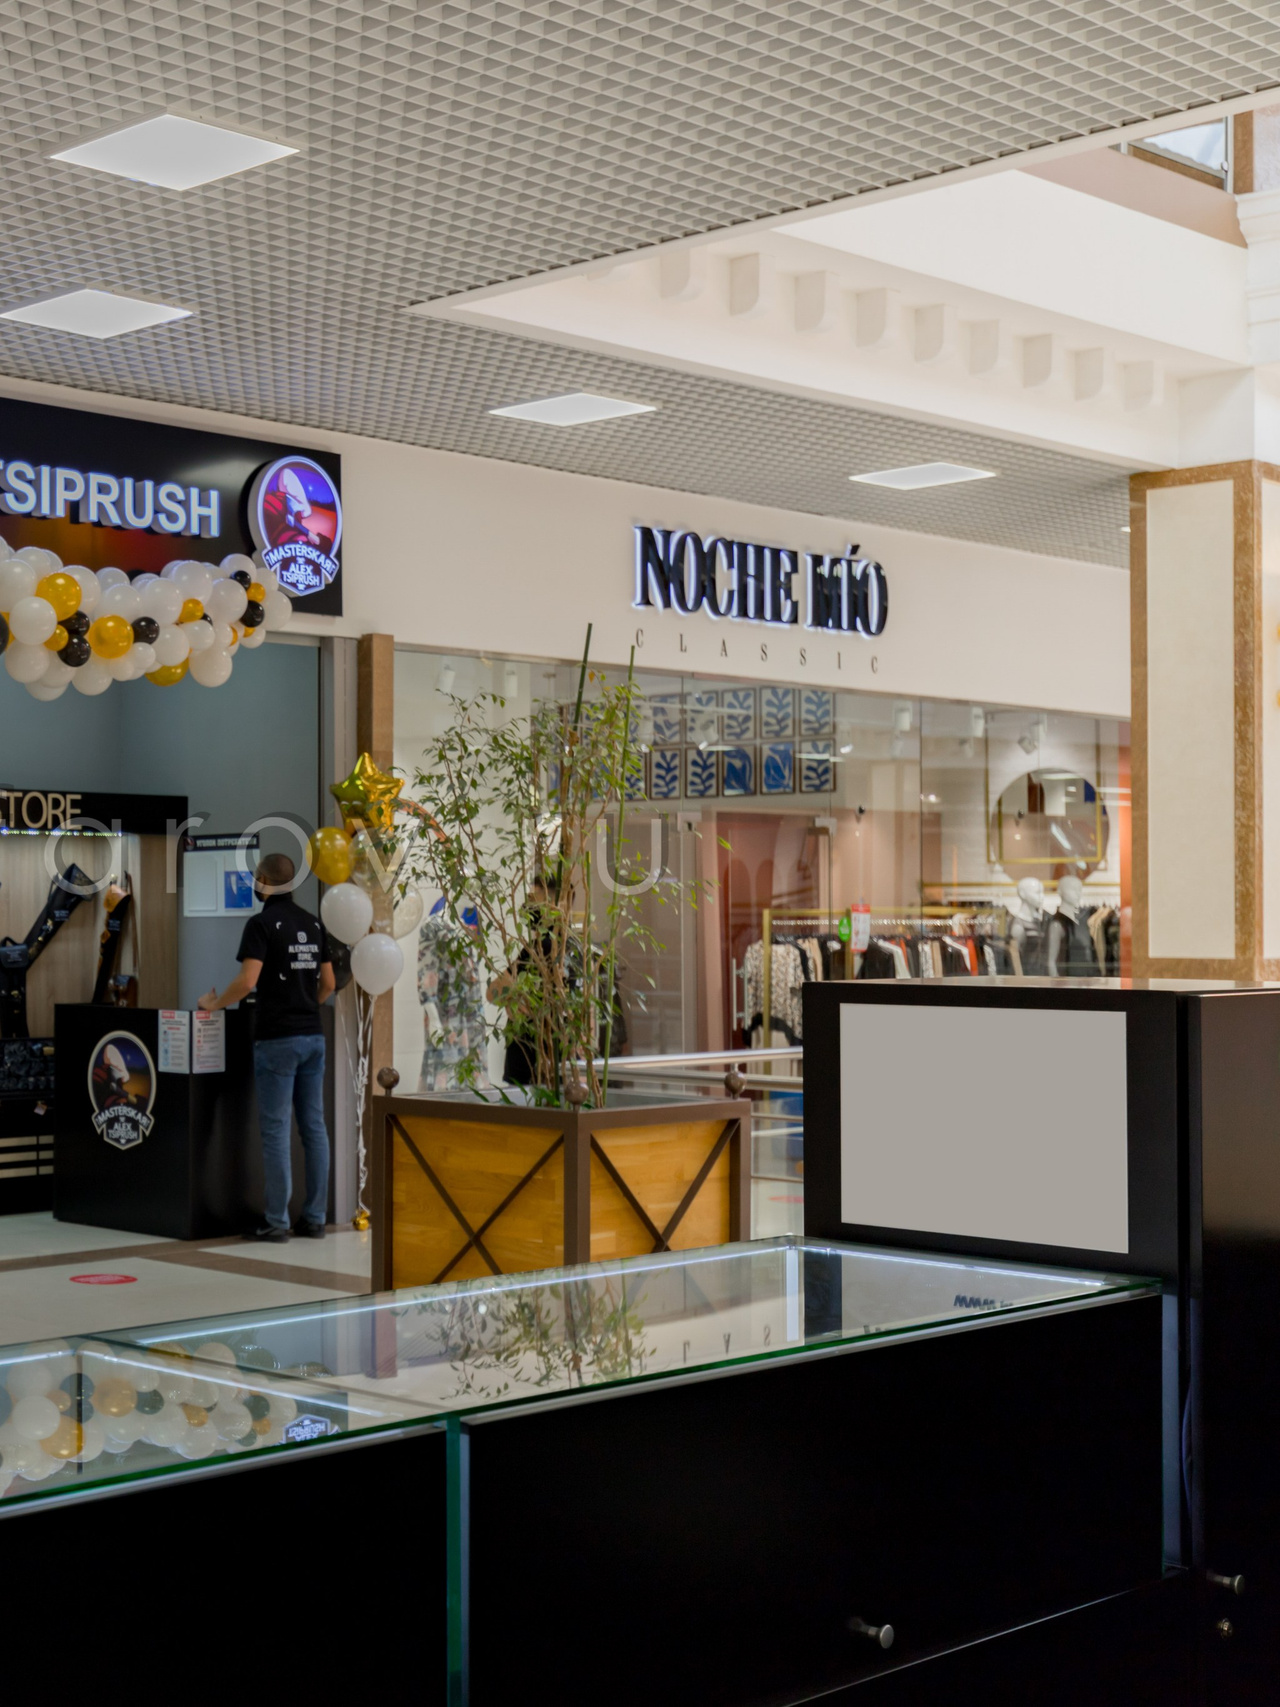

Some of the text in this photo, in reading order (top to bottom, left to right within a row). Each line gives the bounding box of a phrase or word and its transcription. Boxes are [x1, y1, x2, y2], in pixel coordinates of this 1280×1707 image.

[288, 562, 314, 577] ALEX
[281, 570, 320, 586] TSIPRUSH
[632, 526, 889, 638] NOCHE MÍO
[635, 628, 879, 674] CLASSIC
[108, 1129, 138, 1140] TSIPRUSH
[113, 1122, 132, 1132] ALEX
